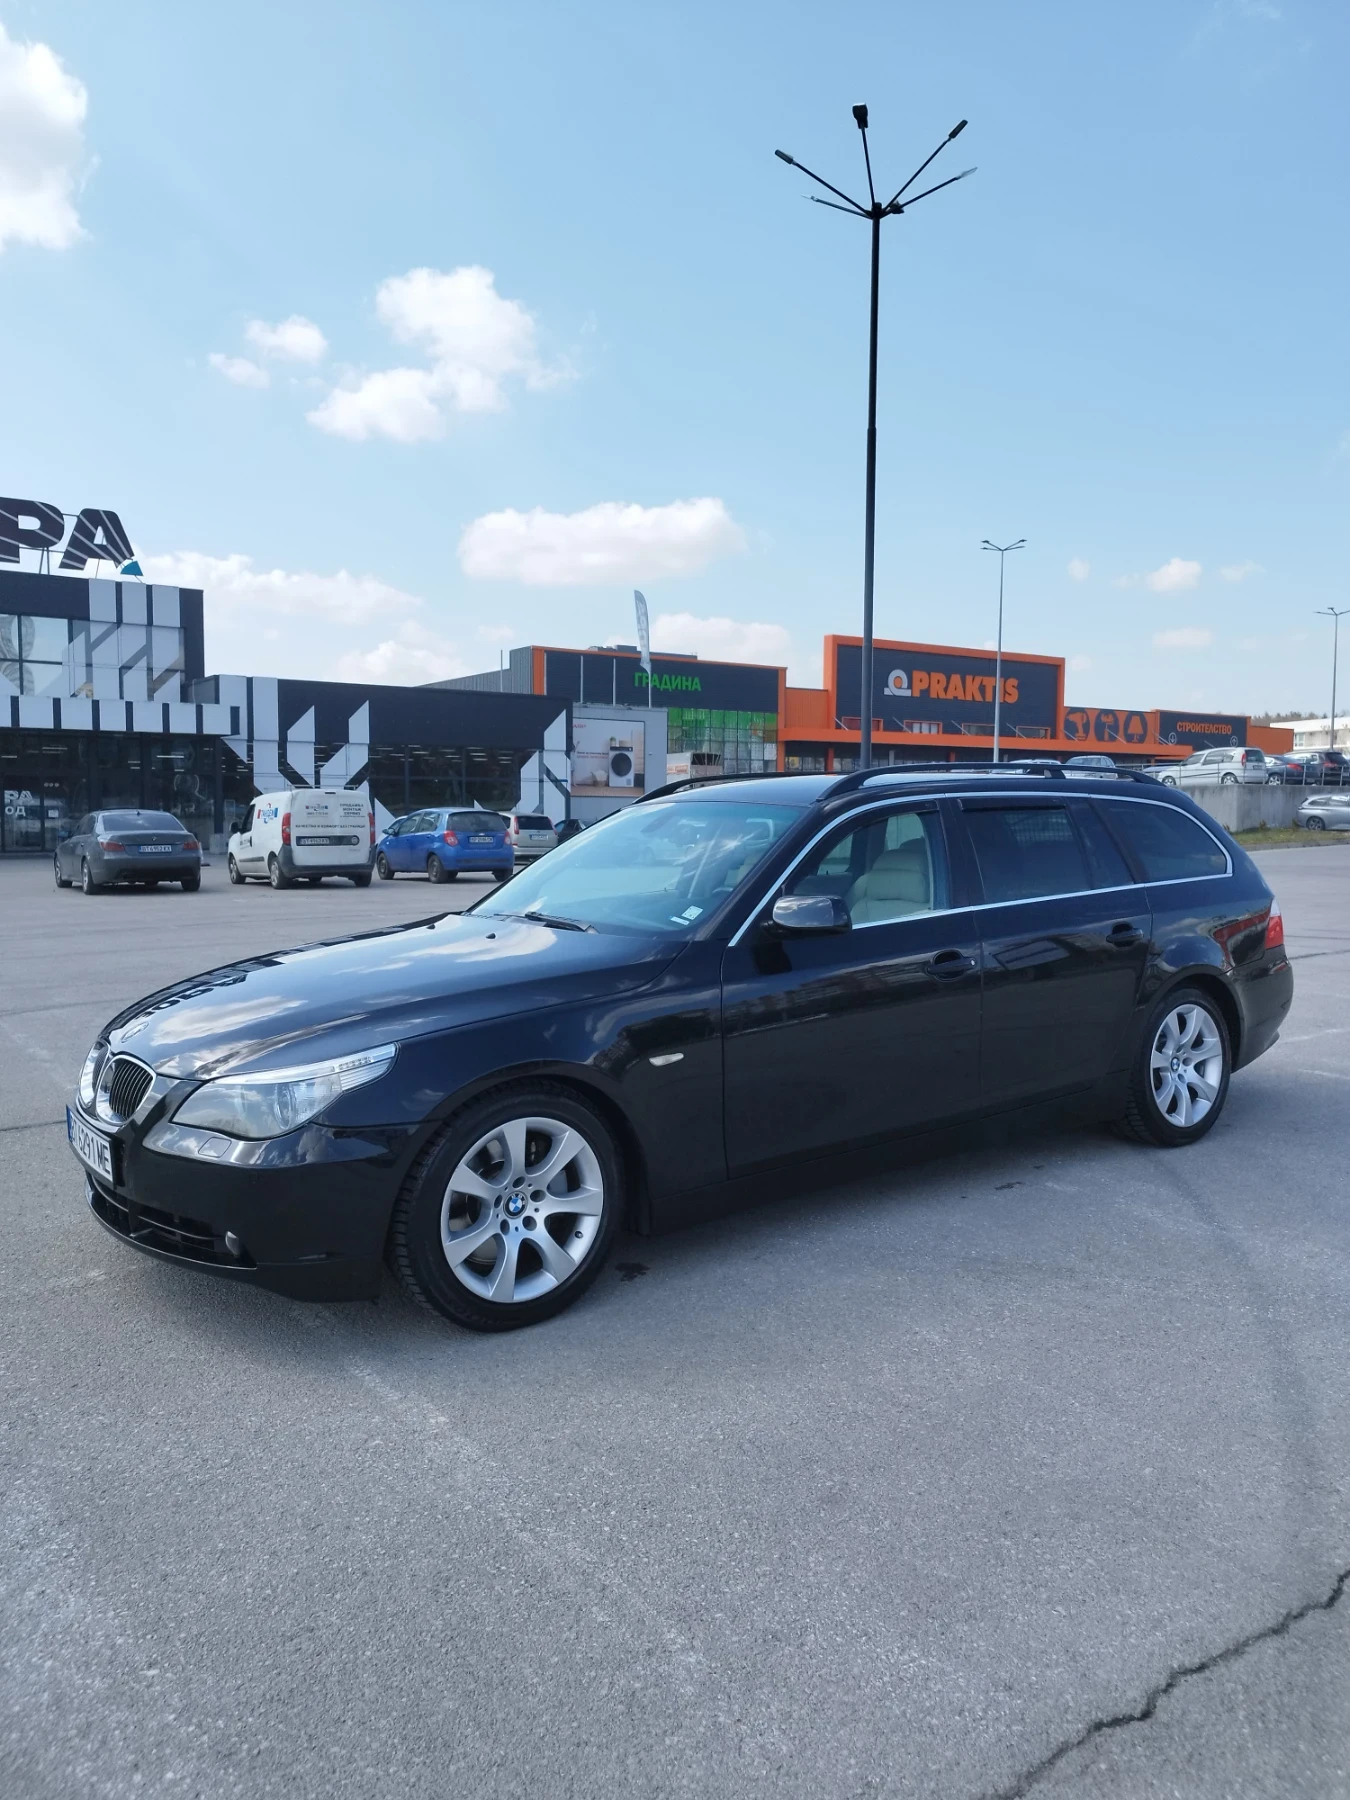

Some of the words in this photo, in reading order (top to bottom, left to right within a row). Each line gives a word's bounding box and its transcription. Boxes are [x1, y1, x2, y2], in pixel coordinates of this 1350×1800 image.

[633, 671, 702, 692] ГРАДИНА
[911, 669, 1019, 704] PRAKTIS
[1176, 721, 1233, 735] СТРОИТЕЛСТВО
